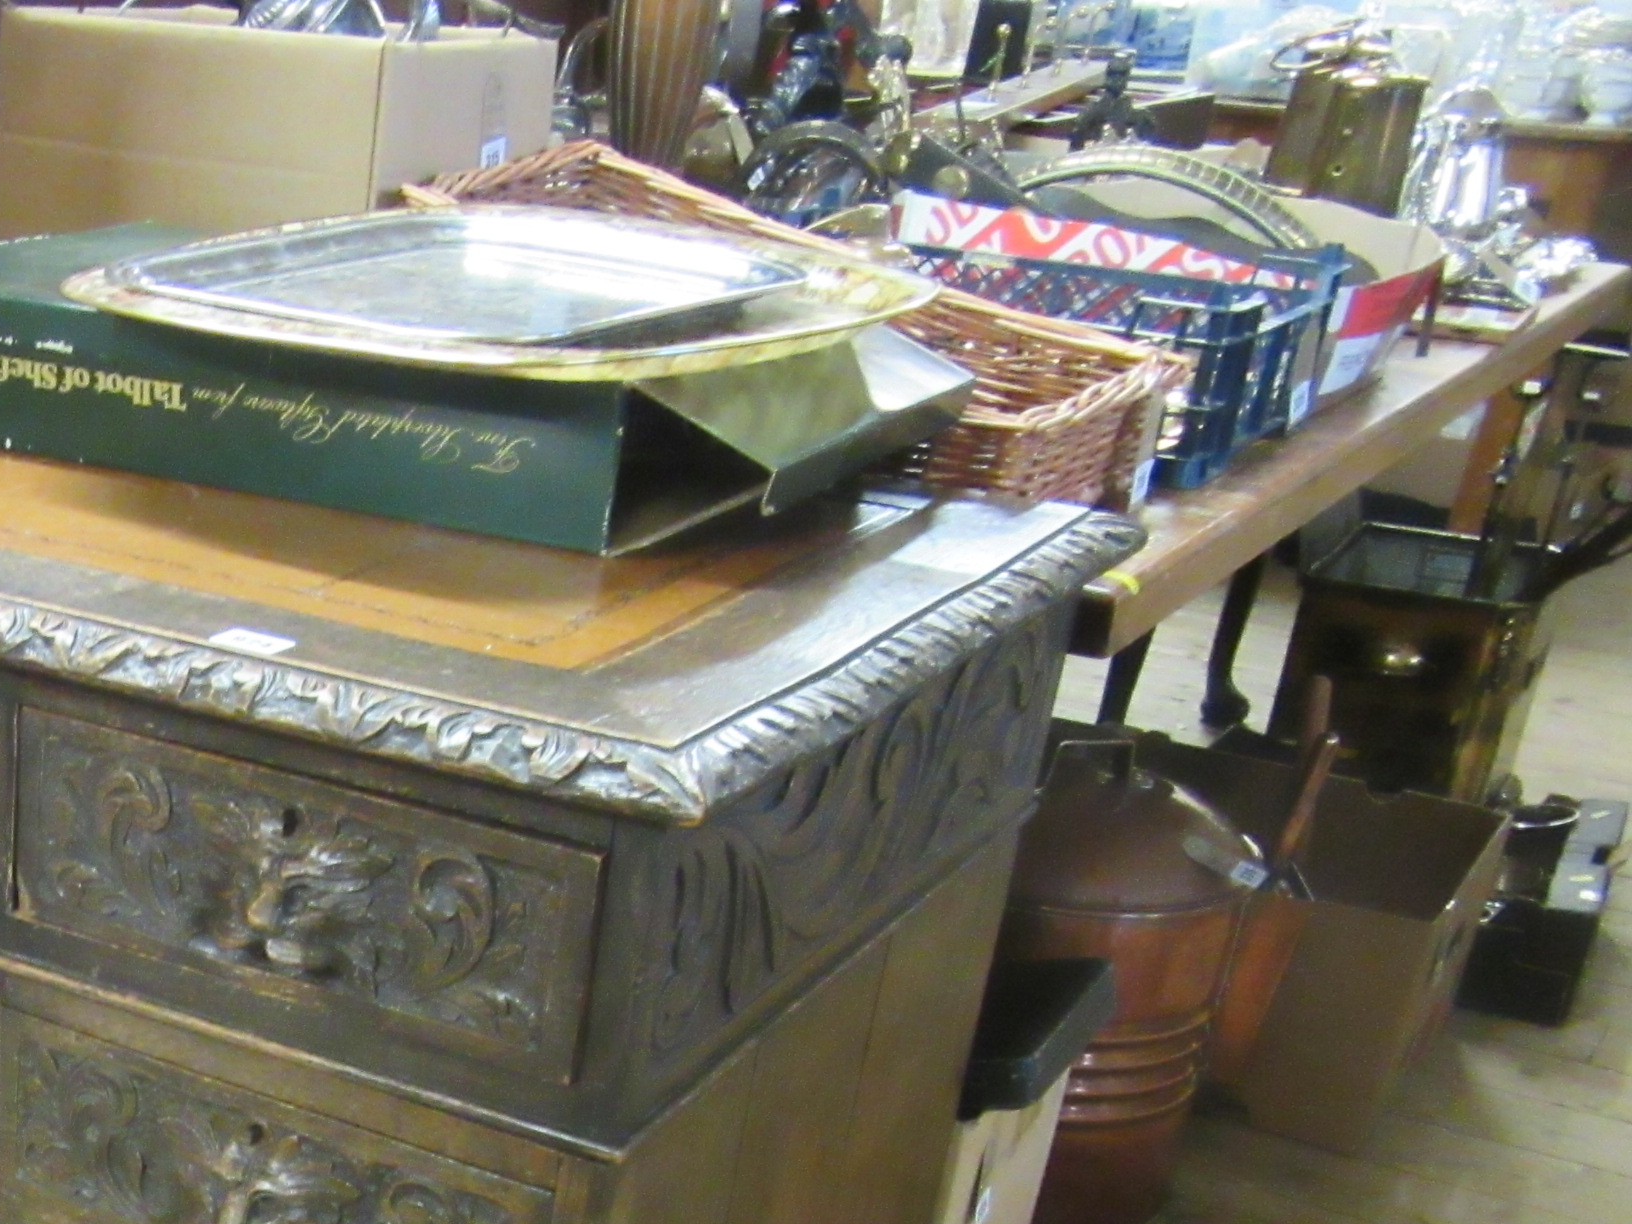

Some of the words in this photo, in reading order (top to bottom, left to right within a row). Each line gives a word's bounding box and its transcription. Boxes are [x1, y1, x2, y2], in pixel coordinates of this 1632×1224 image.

[58, 366, 91, 394] of
[93, 370, 188, 412] Talbot
[192, 382, 246, 420] from
[470, 430, 537, 474] Fine
